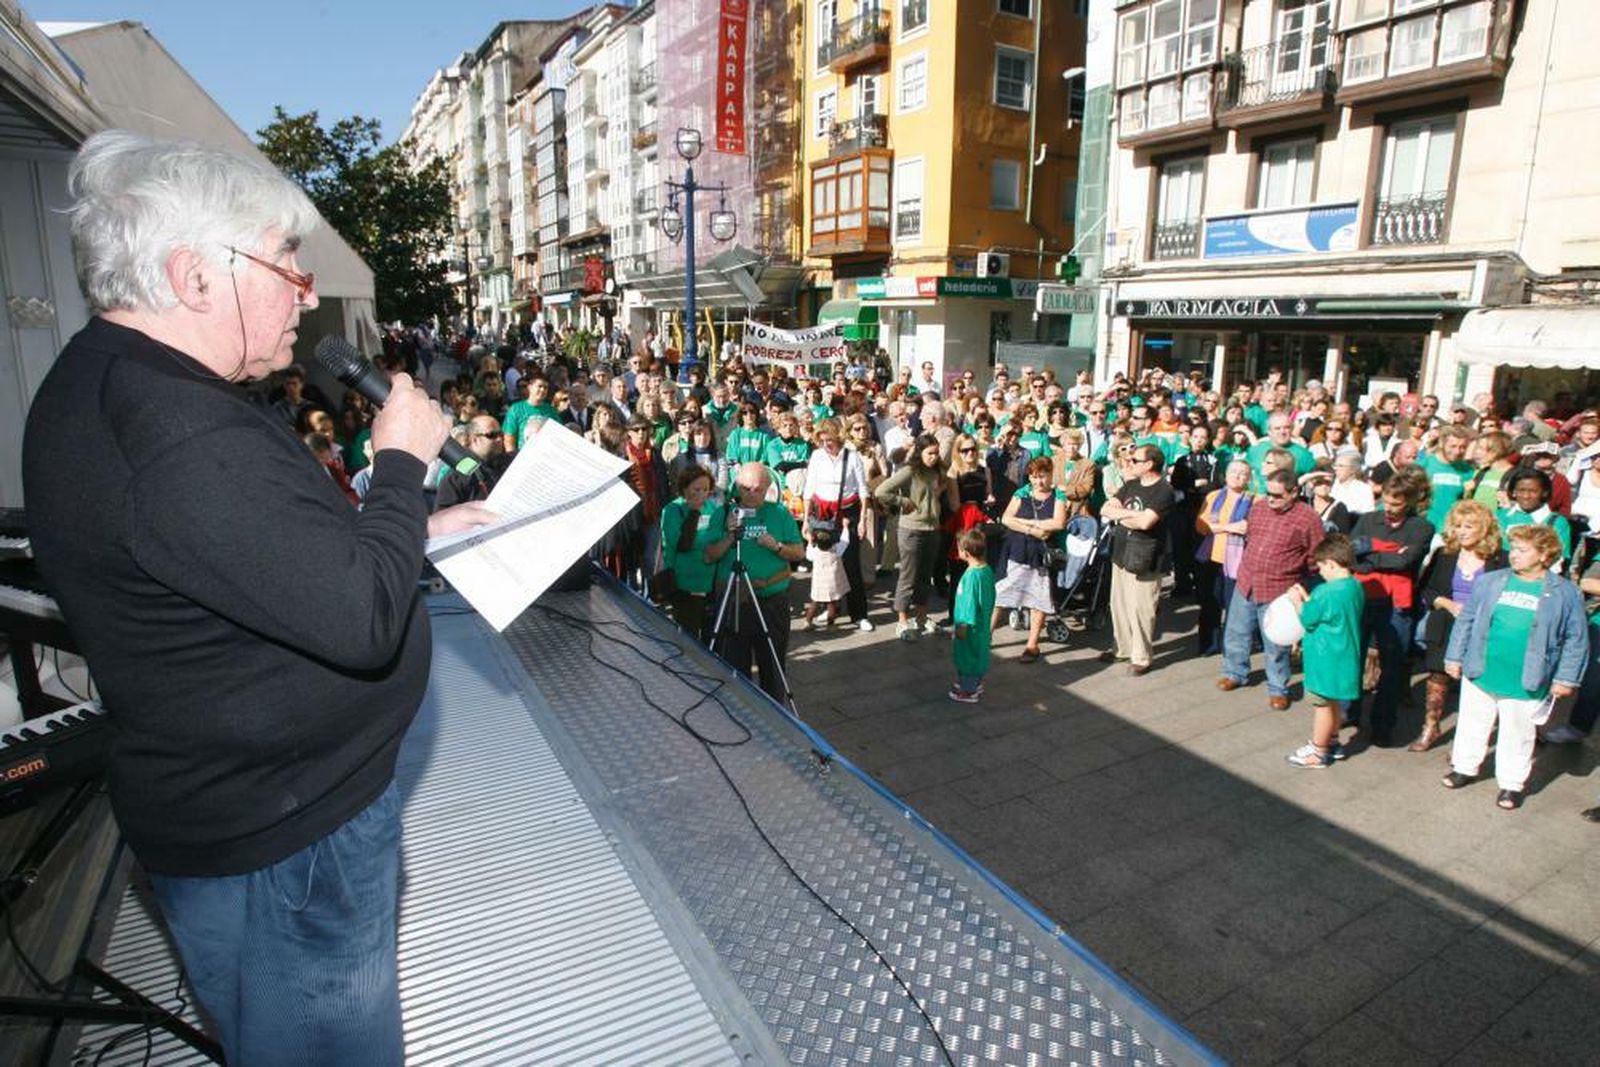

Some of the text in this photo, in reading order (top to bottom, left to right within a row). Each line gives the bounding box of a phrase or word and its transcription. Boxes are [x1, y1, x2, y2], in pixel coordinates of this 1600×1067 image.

[1043, 291, 1095, 311] FARMACIA
[1149, 299, 1281, 317] FARMACIA
[746, 325, 767, 338] NO
[745, 344, 802, 360] POBREZA
[0, 759, 45, 782] .com
